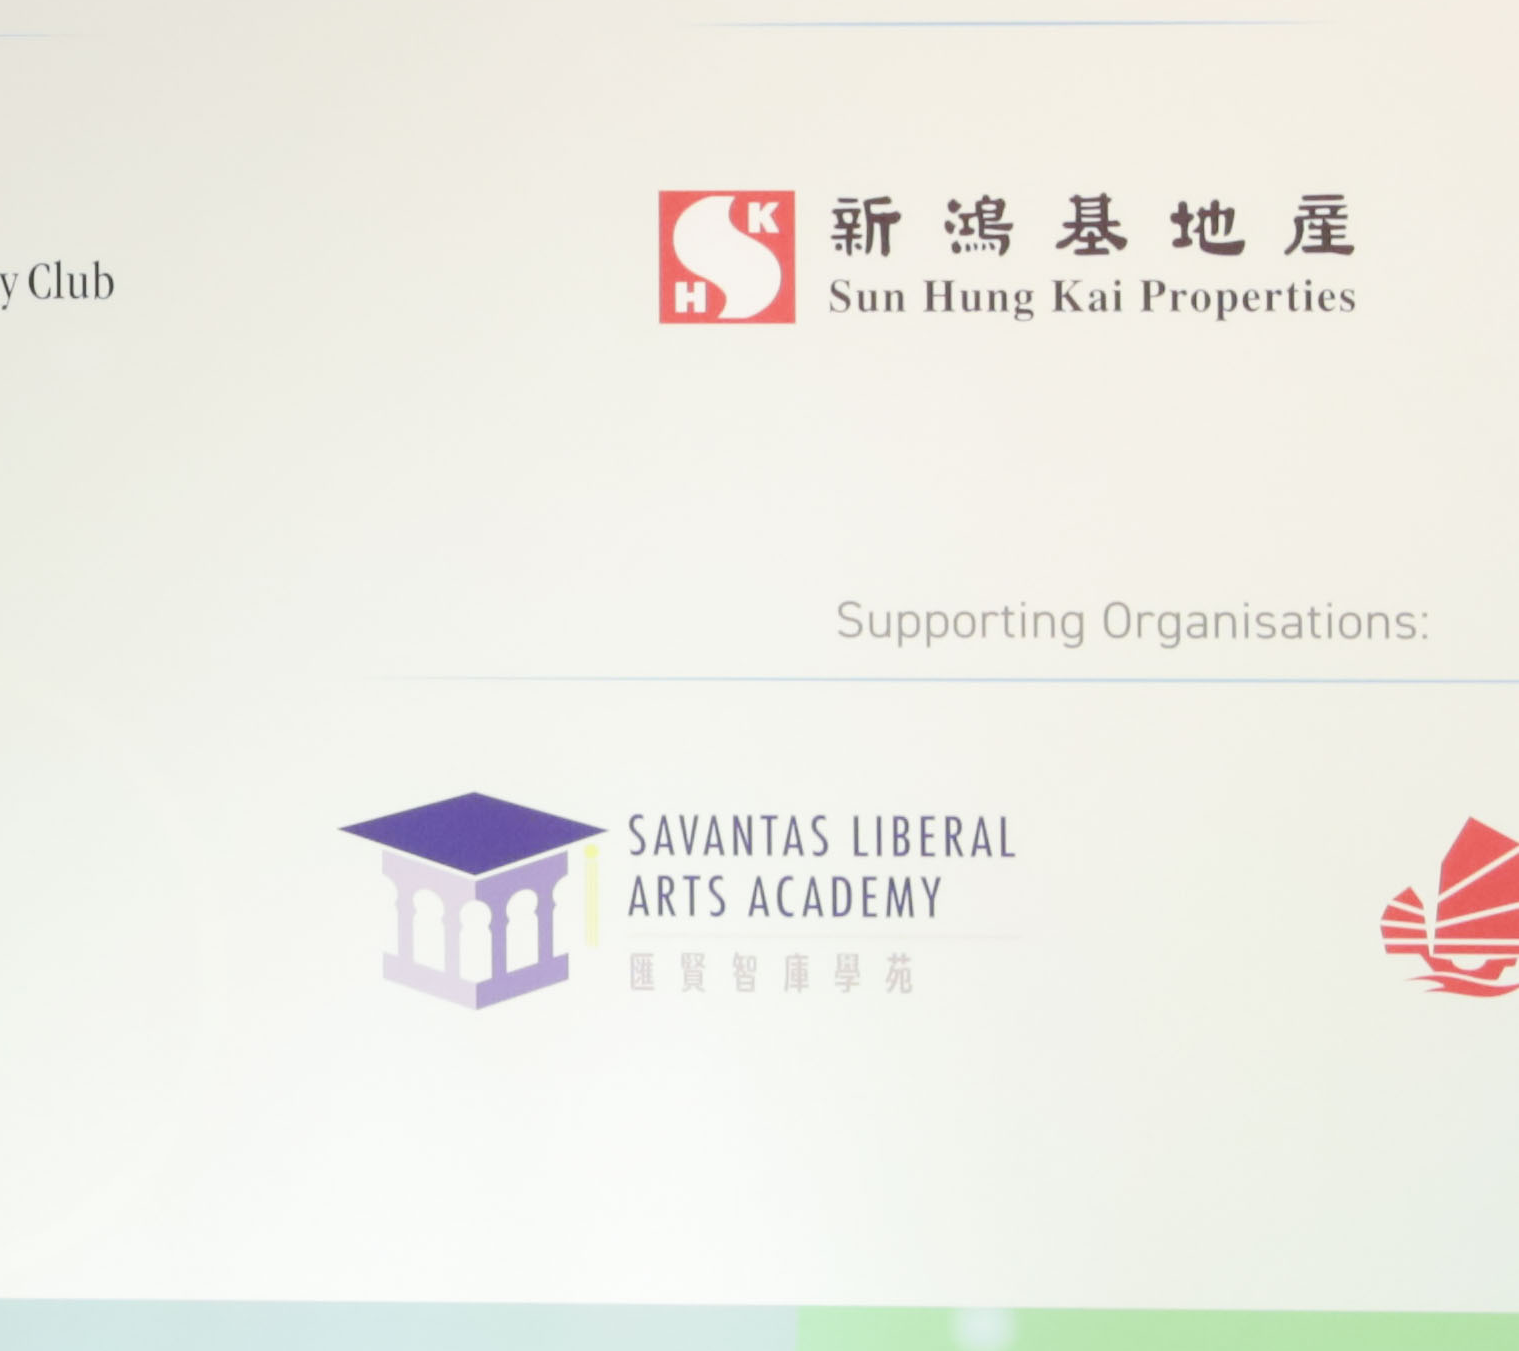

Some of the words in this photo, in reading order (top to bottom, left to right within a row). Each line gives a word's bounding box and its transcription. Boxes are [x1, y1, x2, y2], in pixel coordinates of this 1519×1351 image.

[29, 261, 114, 299] Club
[830, 281, 904, 312] Sun
[926, 281, 1034, 320] Hung
[1054, 280, 1121, 312] Kai
[1143, 280, 1355, 321] Properties
[838, 601, 1084, 649] Supporting
[1104, 601, 1427, 649] Organisations:
[629, 814, 828, 857] SAVANTAS
[854, 816, 1015, 857] LIBERAL
[628, 875, 725, 917] ARTS
[749, 876, 941, 917] ACADEMY
